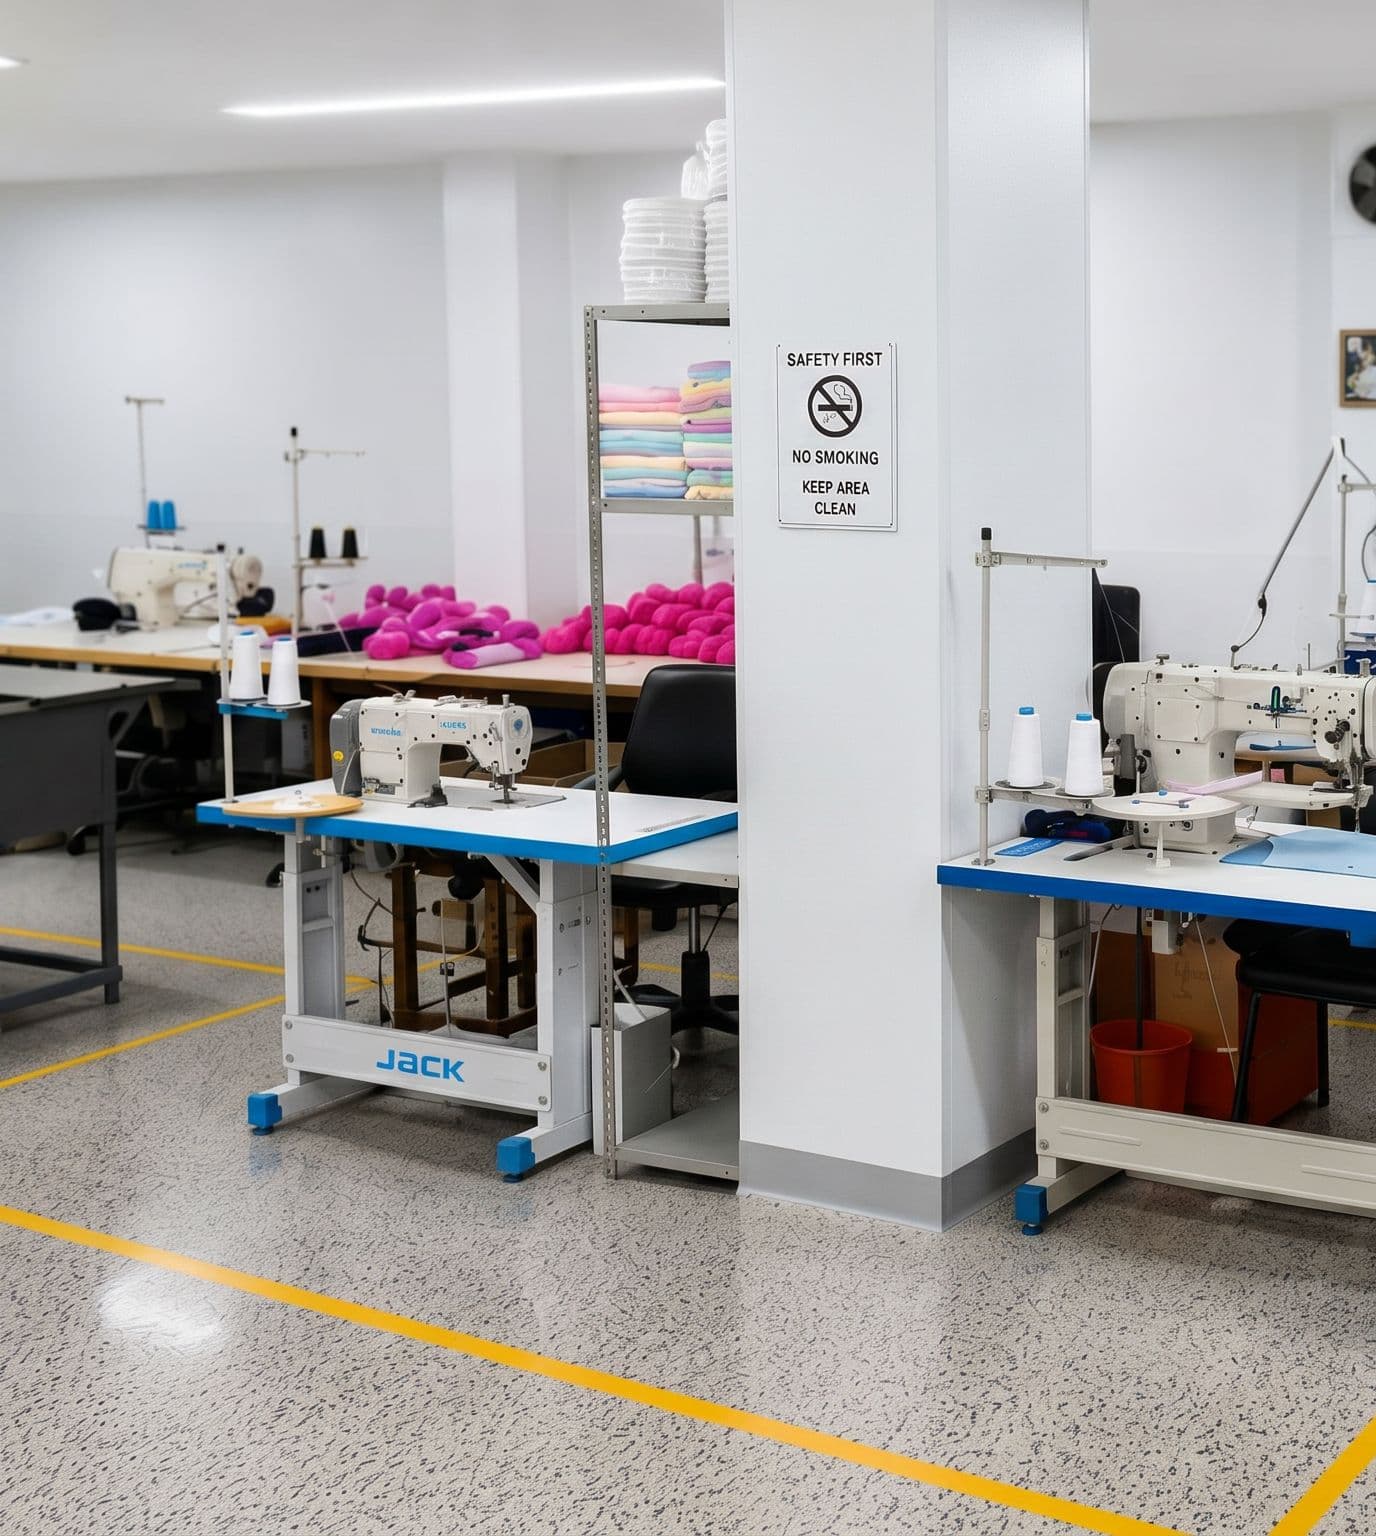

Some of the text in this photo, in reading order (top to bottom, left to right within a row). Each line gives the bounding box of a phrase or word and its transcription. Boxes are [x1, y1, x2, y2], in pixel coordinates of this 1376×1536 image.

[787, 352, 883, 367] SAFETY FIRST
[792, 449, 879, 465] NO SMOKING
[802, 480, 870, 495] KEEP AREA
[814, 501, 856, 516] CLEAN
